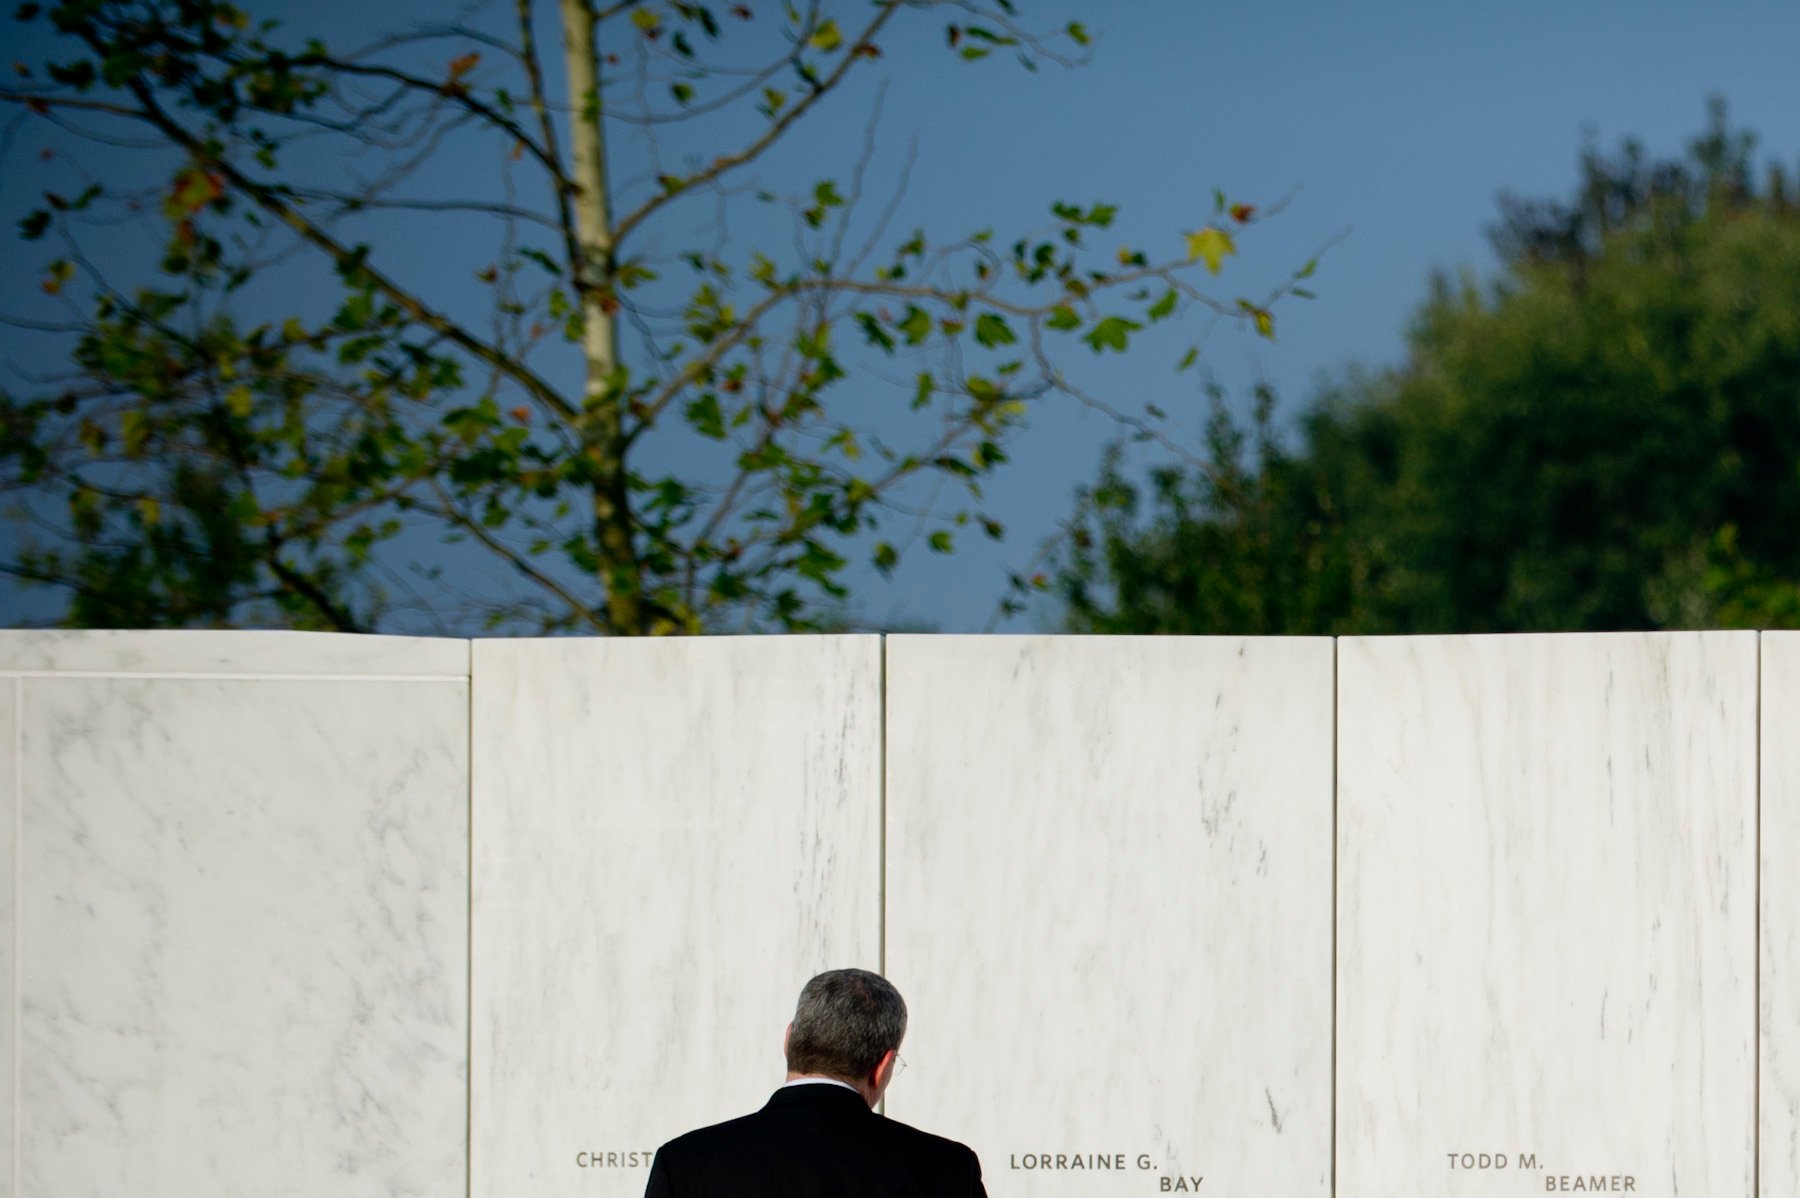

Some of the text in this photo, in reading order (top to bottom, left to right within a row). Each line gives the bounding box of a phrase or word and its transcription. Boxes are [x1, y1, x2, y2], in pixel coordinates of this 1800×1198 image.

[576, 1151, 653, 1168] CHRIST
[1009, 1153, 1159, 1170] LORRAINE G.
[1446, 1152, 1545, 1170] TODD M.
[1159, 1175, 1204, 1193] BAY
[1545, 1175, 1636, 1193] BEAMER
